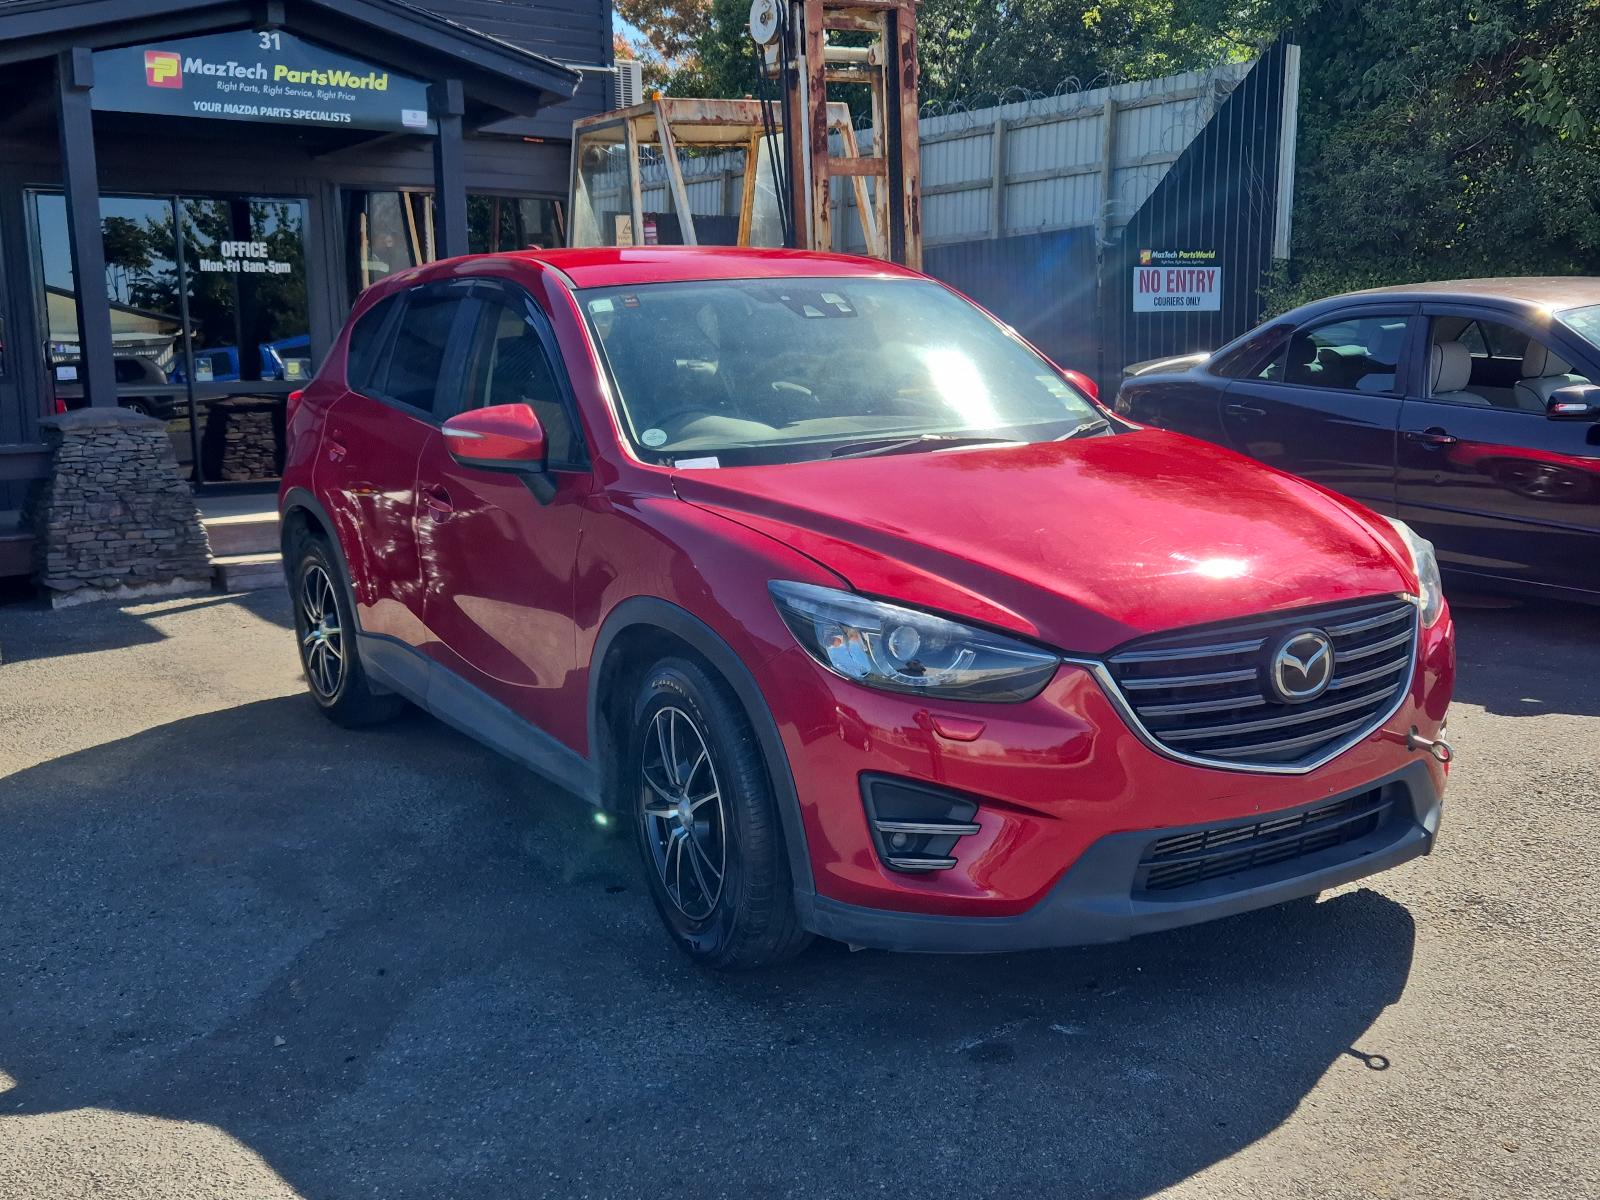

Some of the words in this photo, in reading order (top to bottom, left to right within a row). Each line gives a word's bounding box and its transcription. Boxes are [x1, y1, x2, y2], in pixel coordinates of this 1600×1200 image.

[258, 31, 281, 50] 31
[183, 57, 268, 80] MazTech
[274, 64, 389, 91] PartsWorld
[216, 80, 237, 93] Right
[239, 82, 261, 95] Parts,
[263, 84, 283, 97] Right
[284, 86, 315, 99] Service,
[317, 88, 336, 101] Right
[337, 91, 356, 102] Price
[193, 101, 222, 113] YOUR
[223, 103, 258, 116] MAZDA
[260, 106, 291, 119] PARTS
[292, 108, 352, 123] SPECIALISTS
[221, 240, 268, 258] OFFICE
[1151, 250, 1178, 259] MazTech
[1178, 249, 1216, 259] PartsWorld
[199, 259, 241, 272] Mon-Fri
[242, 260, 292, 275] 8am-5pm
[1139, 269, 1161, 293] NO
[1166, 269, 1216, 293] ENTRY
[1153, 296, 1184, 307] COURIERS
[1185, 296, 1201, 307] ONLY
